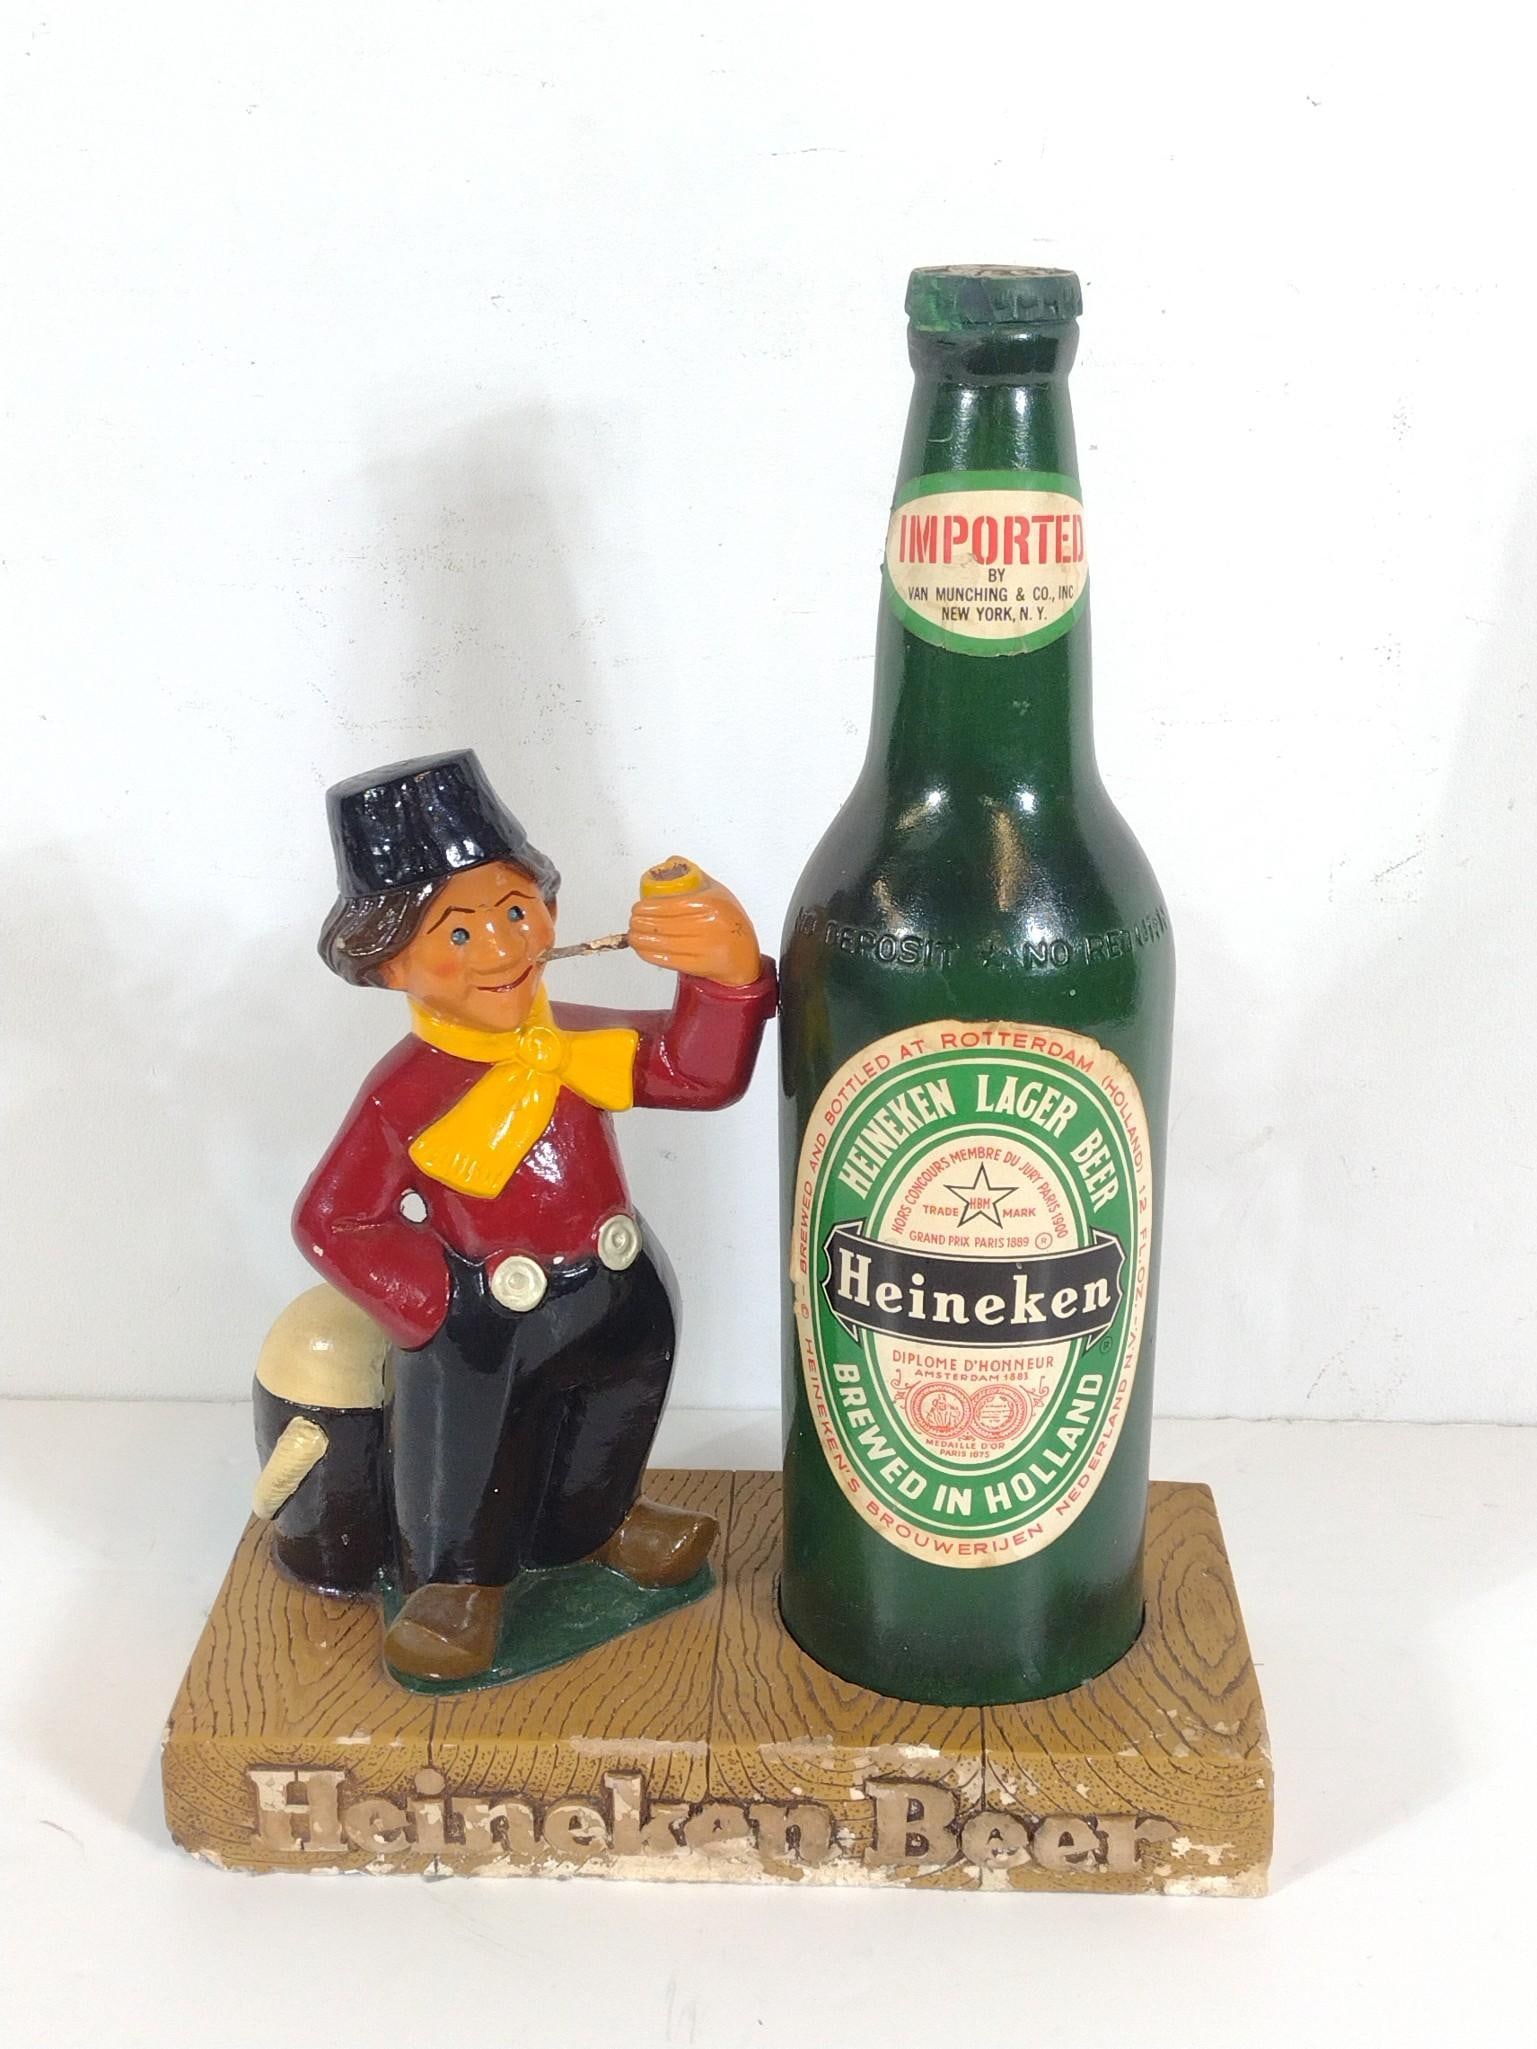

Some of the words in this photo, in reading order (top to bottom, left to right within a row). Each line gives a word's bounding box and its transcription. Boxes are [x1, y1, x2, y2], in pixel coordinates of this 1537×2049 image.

[899, 514, 1085, 565] IMPORTED
[988, 568, 1006, 582] BY
[908, 586, 928, 601] VAN
[936, 587, 1008, 602] MUNCHING
[1016, 587, 1025, 602] &
[1033, 586, 1055, 603] CO.,
[941, 607, 970, 621] NEW
[976, 607, 1016, 623] YORK,
[825, 919, 956, 971] DEPOSIT
[1021, 937, 1073, 970] NO
[800, 1181, 812, 1274] BREWED
[809, 1133, 826, 1174] AND
[824, 1054, 891, 1127] BOTTLED
[900, 1039, 924, 1061] AT
[941, 1032, 1094, 1073] ROTTERDAM
[1102, 1075, 1144, 1174] (HOLLAND)
[837, 1078, 956, 1200] HEINEKEN
[975, 1074, 1078, 1139] LAGER
[1070, 1127, 1120, 1213] BEER
[891, 1204, 912, 1235] HORS
[905, 1157, 950, 1205] CONCOURS
[949, 1146, 1002, 1164] MEMBRE
[1003, 1151, 1021, 1167] DU
[1018, 1162, 1044, 1184] JURY
[1037, 1181, 1060, 1214] PARIS
[1051, 1212, 1068, 1239] 1900
[969, 1197, 991, 1210] HBM
[923, 1205, 958, 1217] TRADE
[1002, 1208, 1036, 1218] MARK
[909, 1230, 946, 1245] GRAND
[948, 1235, 970, 1247] PRIX
[975, 1237, 1004, 1249] PARIS
[1006, 1236, 1029, 1248] 1889
[837, 1247, 1111, 1326] Heineken
[892, 1350, 957, 1371] DIPLOME
[964, 1356, 1054, 1372] D'HONNEUR
[914, 1369, 999, 1382] AMSTERDAM
[804, 1337, 861, 1493] HEINEKEN'S
[866, 1500, 1044, 1556] BROUWERIJEN
[1055, 1378, 1128, 1516] NEDERLAND
[833, 1363, 927, 1500] BREWED
[932, 1484, 972, 1516] IN
[984, 1373, 1103, 1514] HOLLAND
[925, 1438, 976, 1450] MEDAILLE
[939, 1449, 966, 1458] PARIS
[248, 1768, 839, 1867] Heineken
[862, 1778, 1181, 1873] Beer
